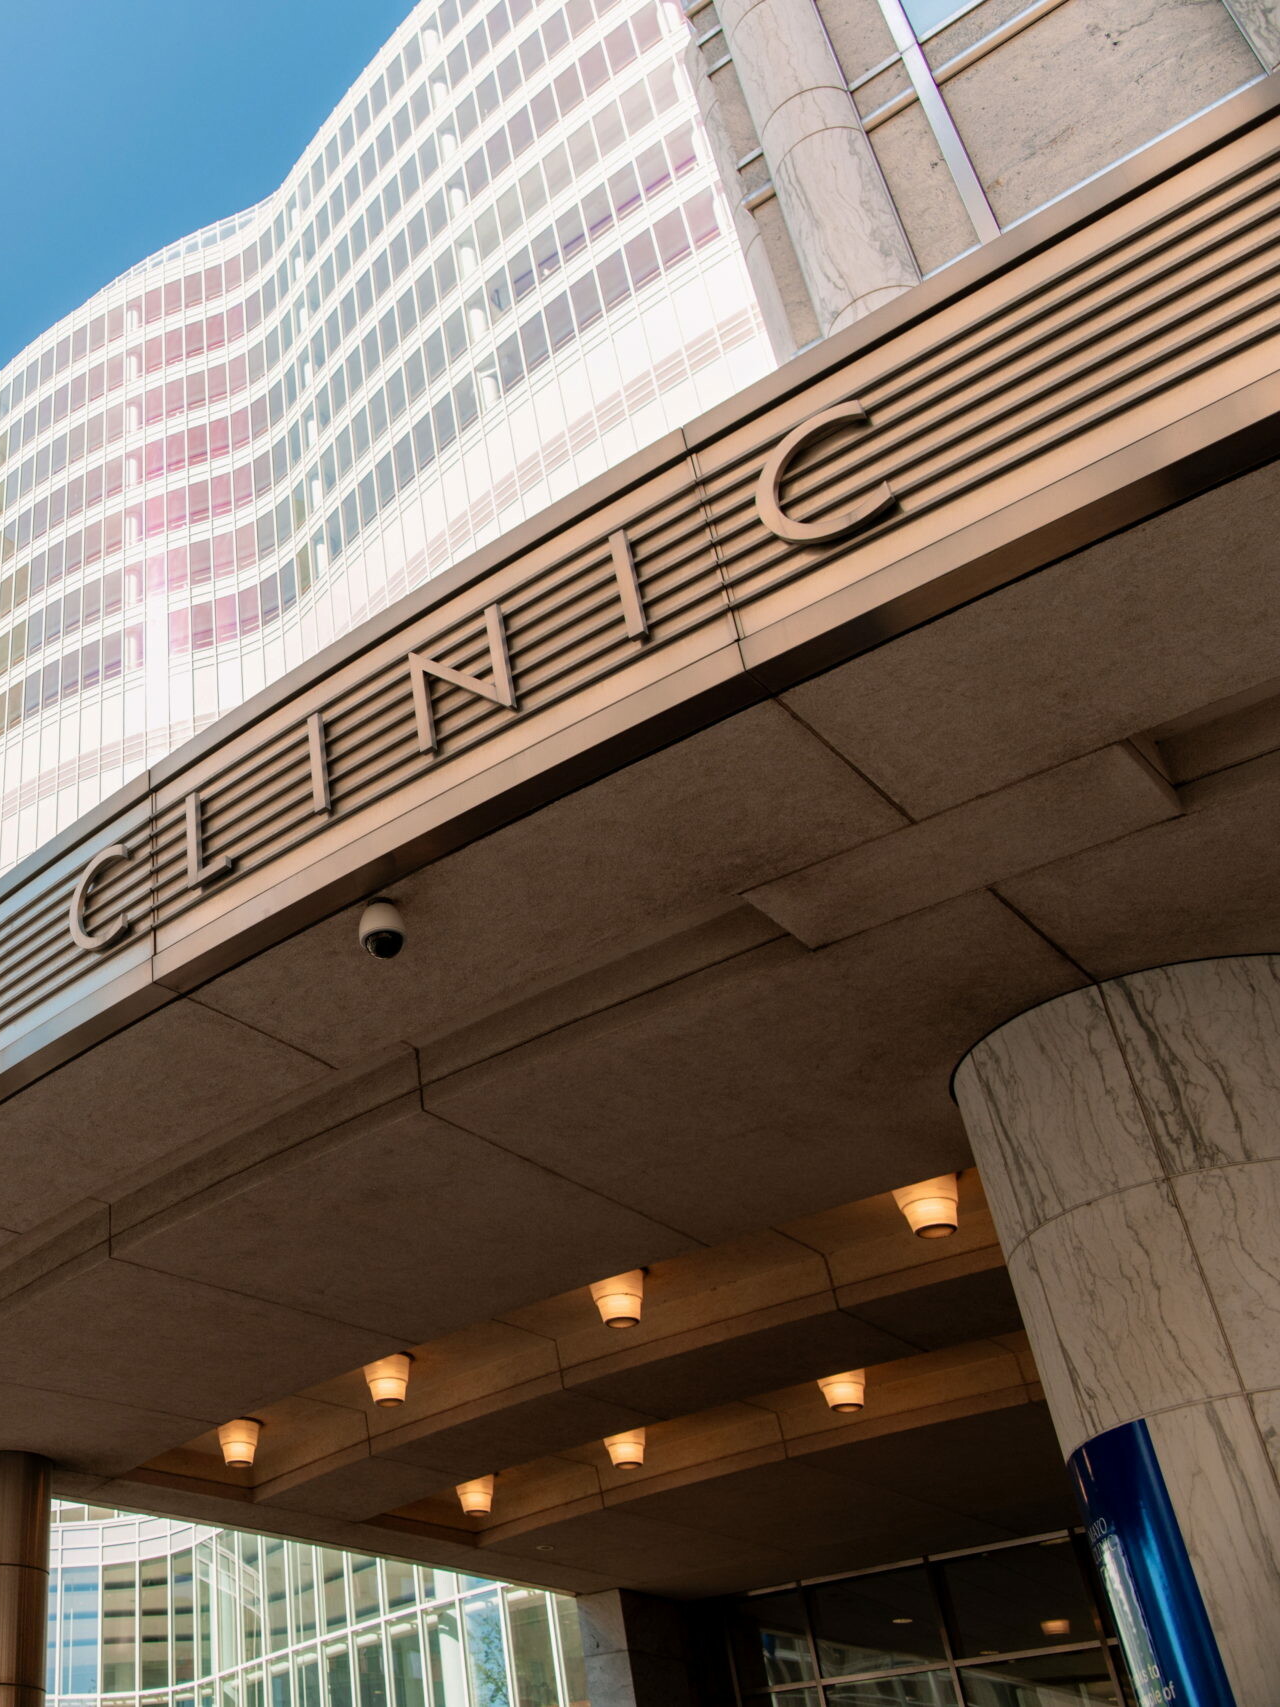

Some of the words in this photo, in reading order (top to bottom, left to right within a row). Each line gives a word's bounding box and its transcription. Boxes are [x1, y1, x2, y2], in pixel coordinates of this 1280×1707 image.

[69, 400, 896, 951] CLINIC
[1147, 1664, 1160, 1680] to
[1162, 1680, 1176, 1700] of
